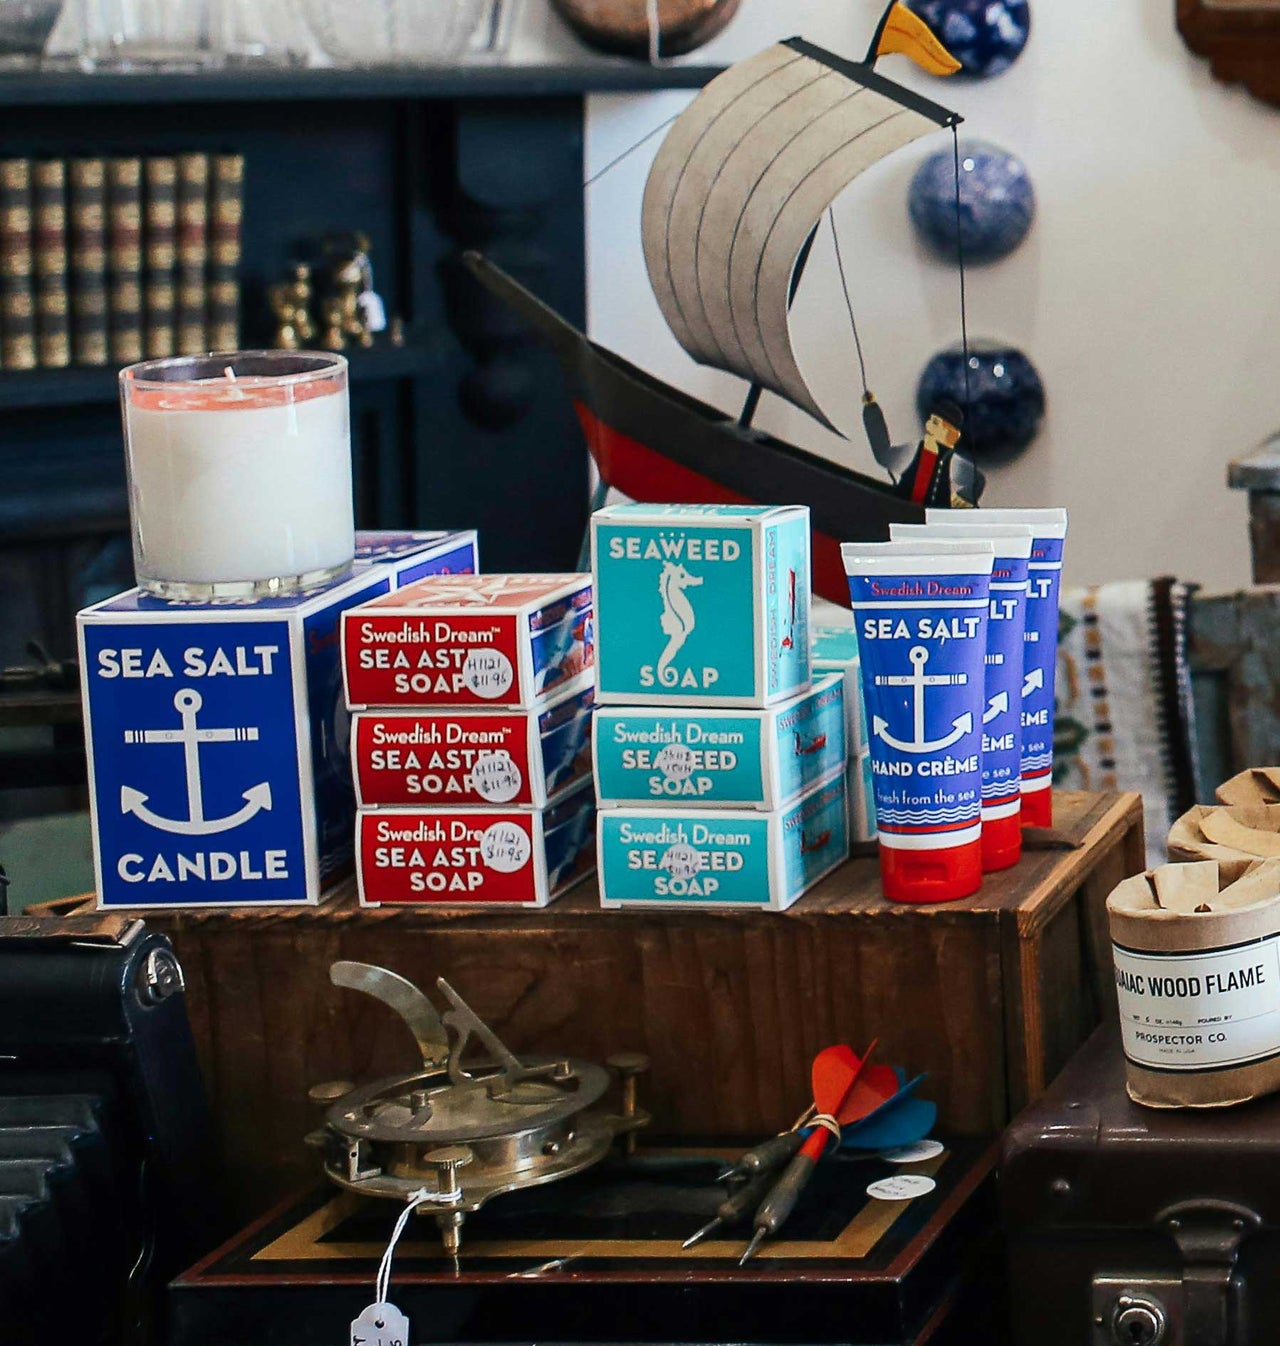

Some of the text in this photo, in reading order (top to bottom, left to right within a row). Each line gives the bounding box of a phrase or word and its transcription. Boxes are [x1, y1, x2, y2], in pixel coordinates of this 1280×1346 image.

[609, 537, 741, 562] SEAWEED
[872, 582, 923, 597] Swedish
[361, 622, 430, 643] Swedish
[864, 617, 981, 640] SEA SALT
[98, 646, 279, 678] SEA SALT
[360, 649, 467, 669] SEA AST
[395, 674, 467, 693] SOAP
[639, 665, 719, 689] SOAP
[373, 723, 441, 744] Swedish
[614, 722, 744, 744] Swedish Dream
[371, 750, 421, 770] SEA
[622, 750, 737, 771] SEEED
[873, 755, 979, 777] HAND CRÈME
[406, 774, 476, 794] SOAP
[649, 777, 713, 795] SOAP
[903, 789, 931, 805] from
[935, 789, 954, 804] the
[958, 790, 975, 801] sea
[377, 821, 484, 842] Swedish Dre
[620, 823, 750, 845] Swedish Dream
[117, 850, 289, 883] CANDLE
[375, 848, 487, 868] SEA AST
[628, 850, 743, 871] SEEED
[410, 872, 484, 892] SOAP
[654, 877, 719, 896] SOAP
[1148, 976, 1201, 998] WOOD
[1206, 964, 1265, 995] FLAME
[1136, 1031, 1202, 1045] PROSPECTOR
